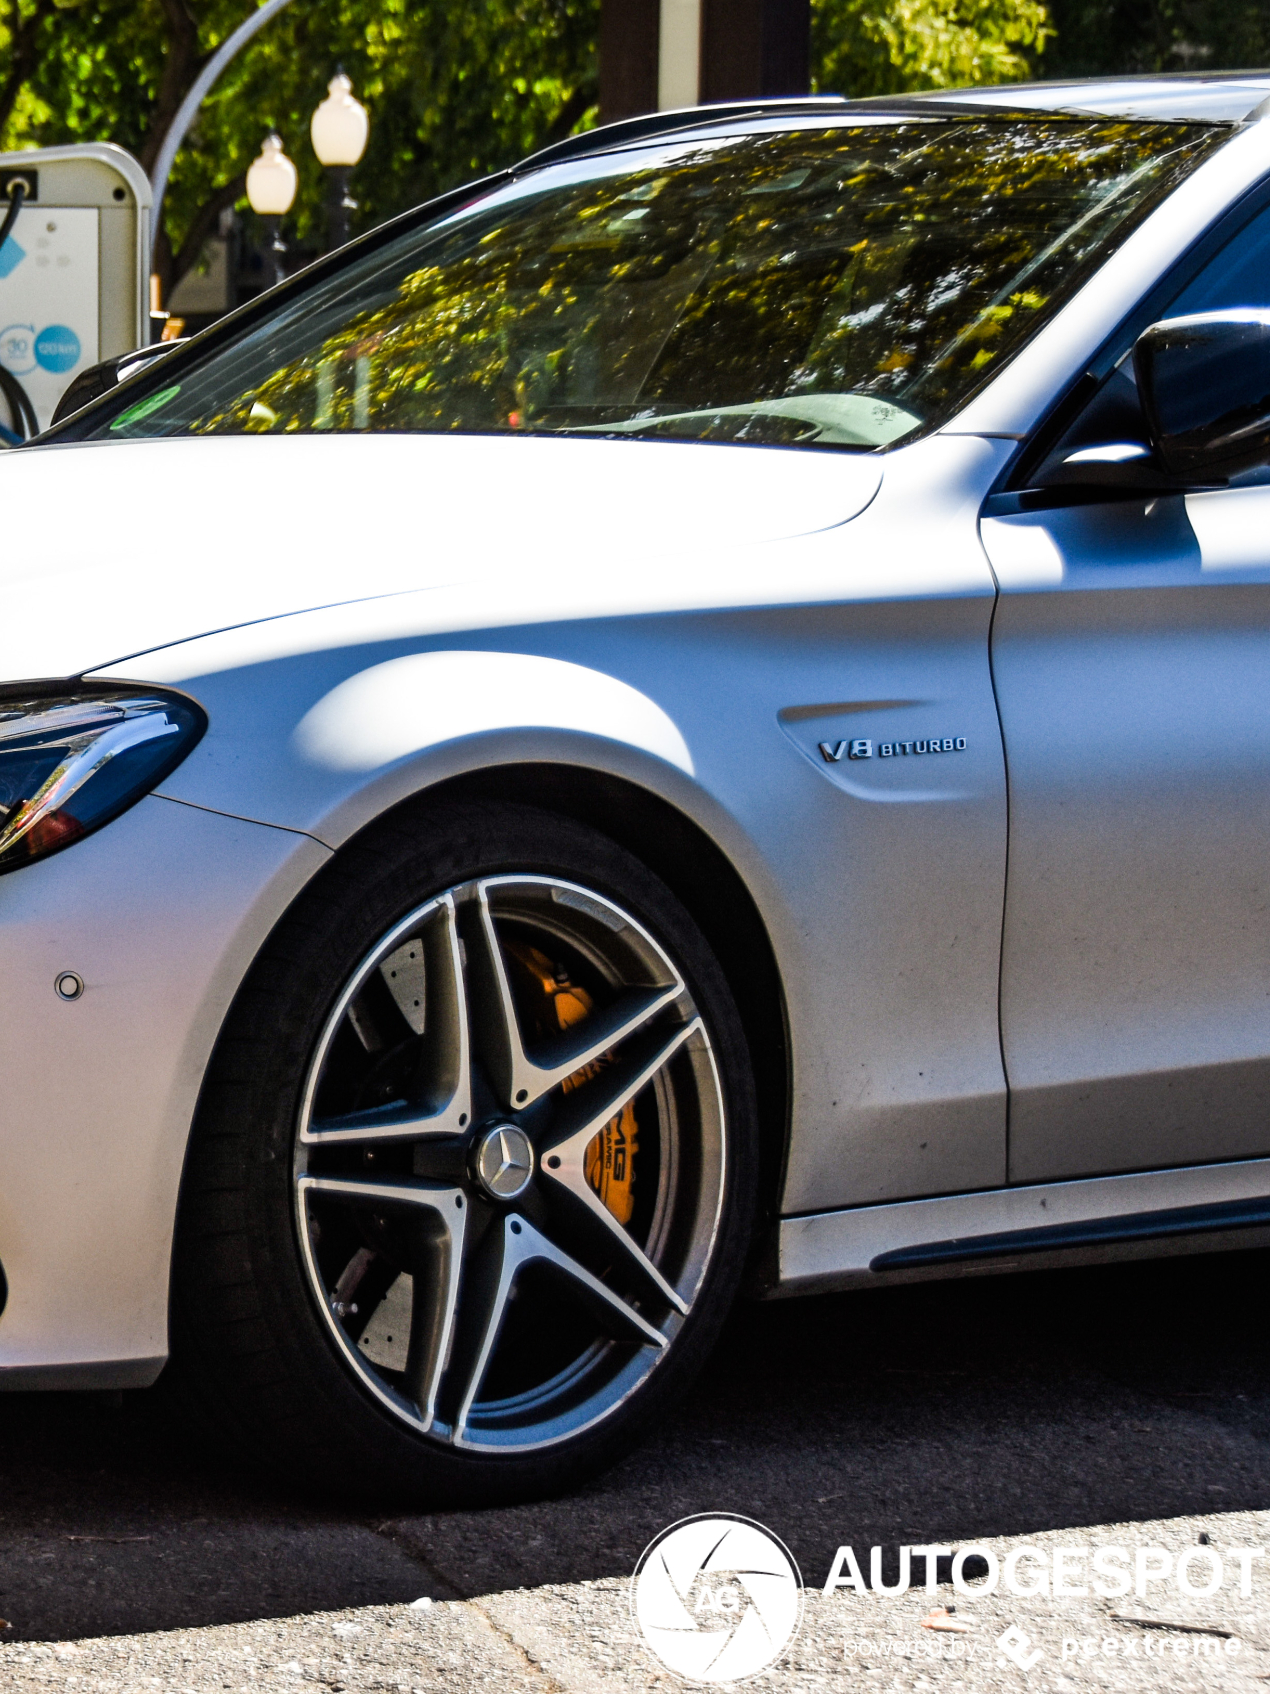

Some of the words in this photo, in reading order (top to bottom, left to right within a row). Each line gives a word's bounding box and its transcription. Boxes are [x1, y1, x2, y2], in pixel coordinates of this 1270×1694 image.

[818, 738, 873, 763] V8
[879, 737, 968, 758] BITURBO
[613, 1109, 626, 1181] MG
